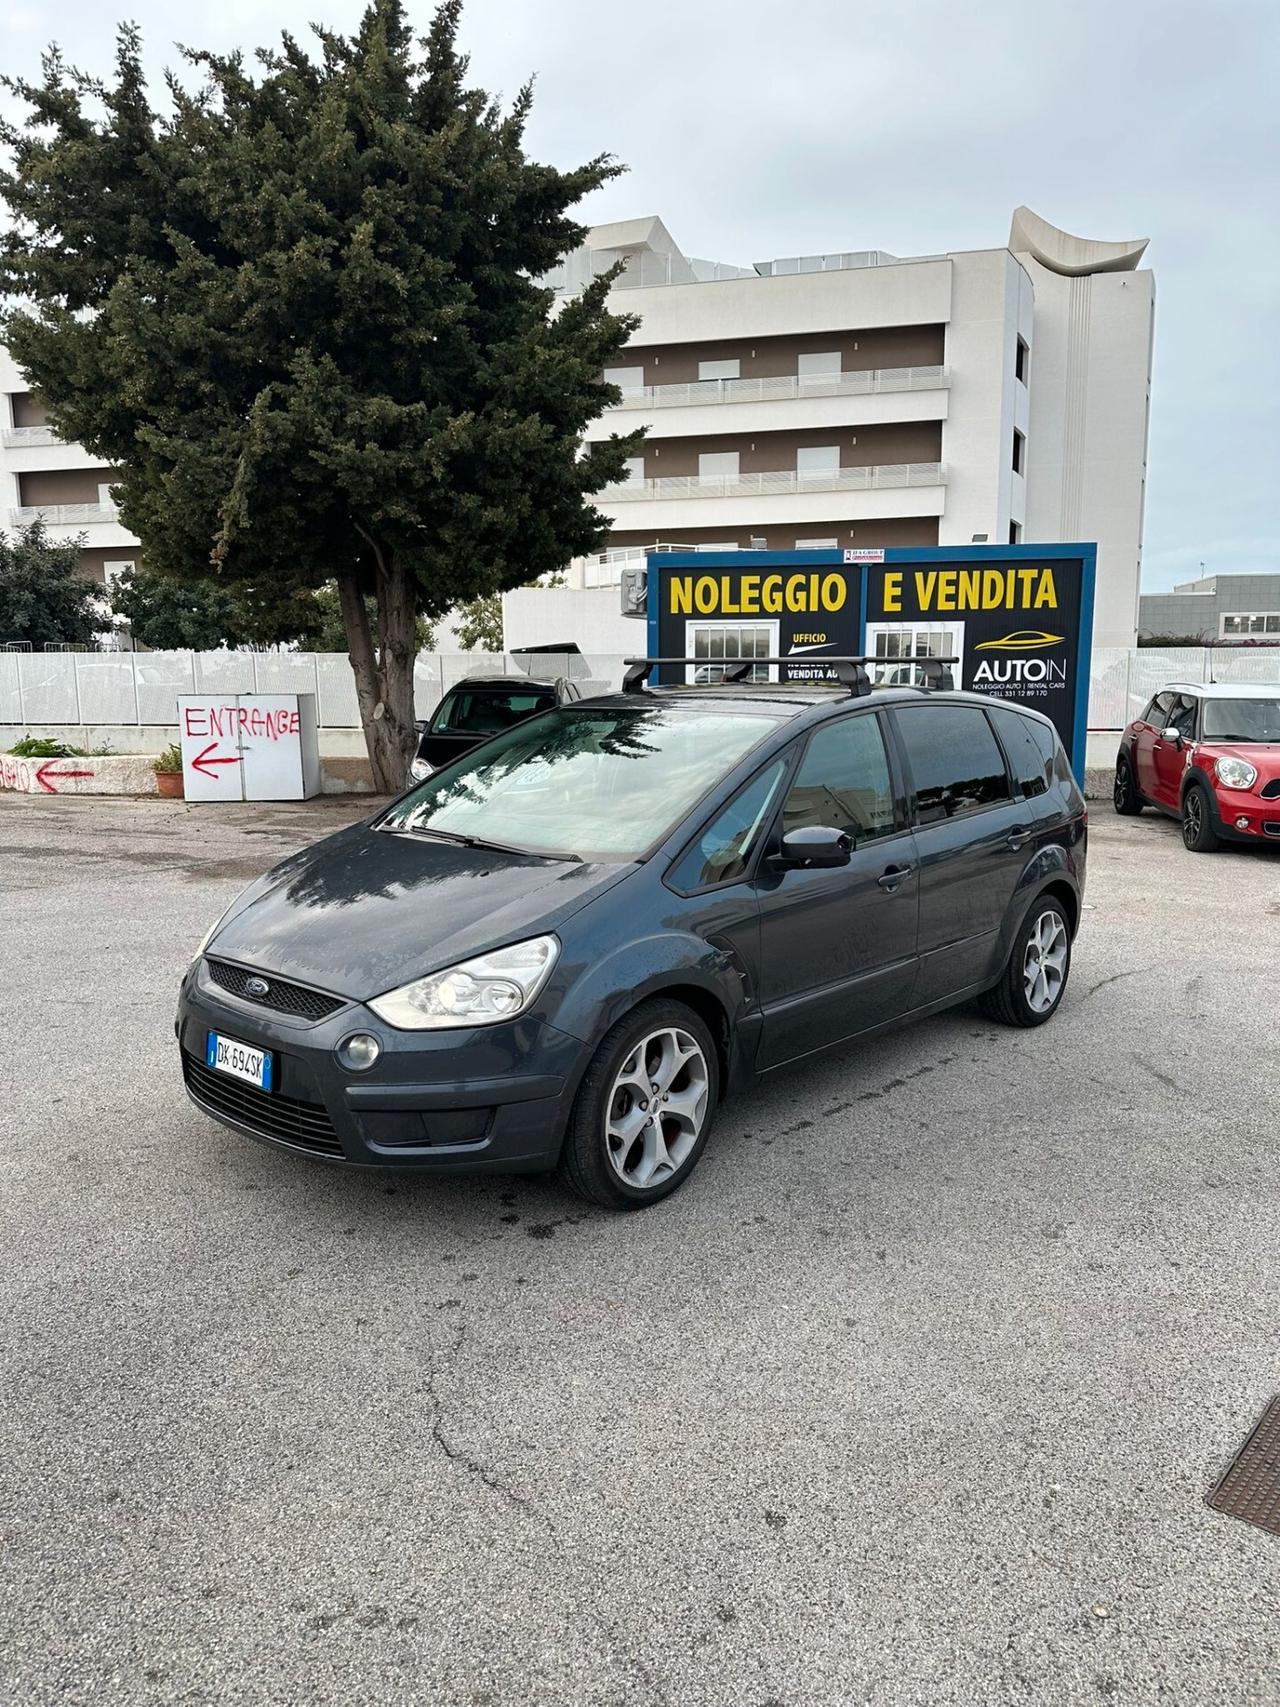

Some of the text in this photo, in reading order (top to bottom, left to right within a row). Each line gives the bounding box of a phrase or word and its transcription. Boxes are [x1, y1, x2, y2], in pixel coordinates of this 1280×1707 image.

[670, 568, 1058, 614] NOLEGGIO E VENDITA
[793, 633, 826, 643] UFFICIO
[787, 669, 824, 679] VENDITA
[973, 659, 1066, 681] AUTOIN
